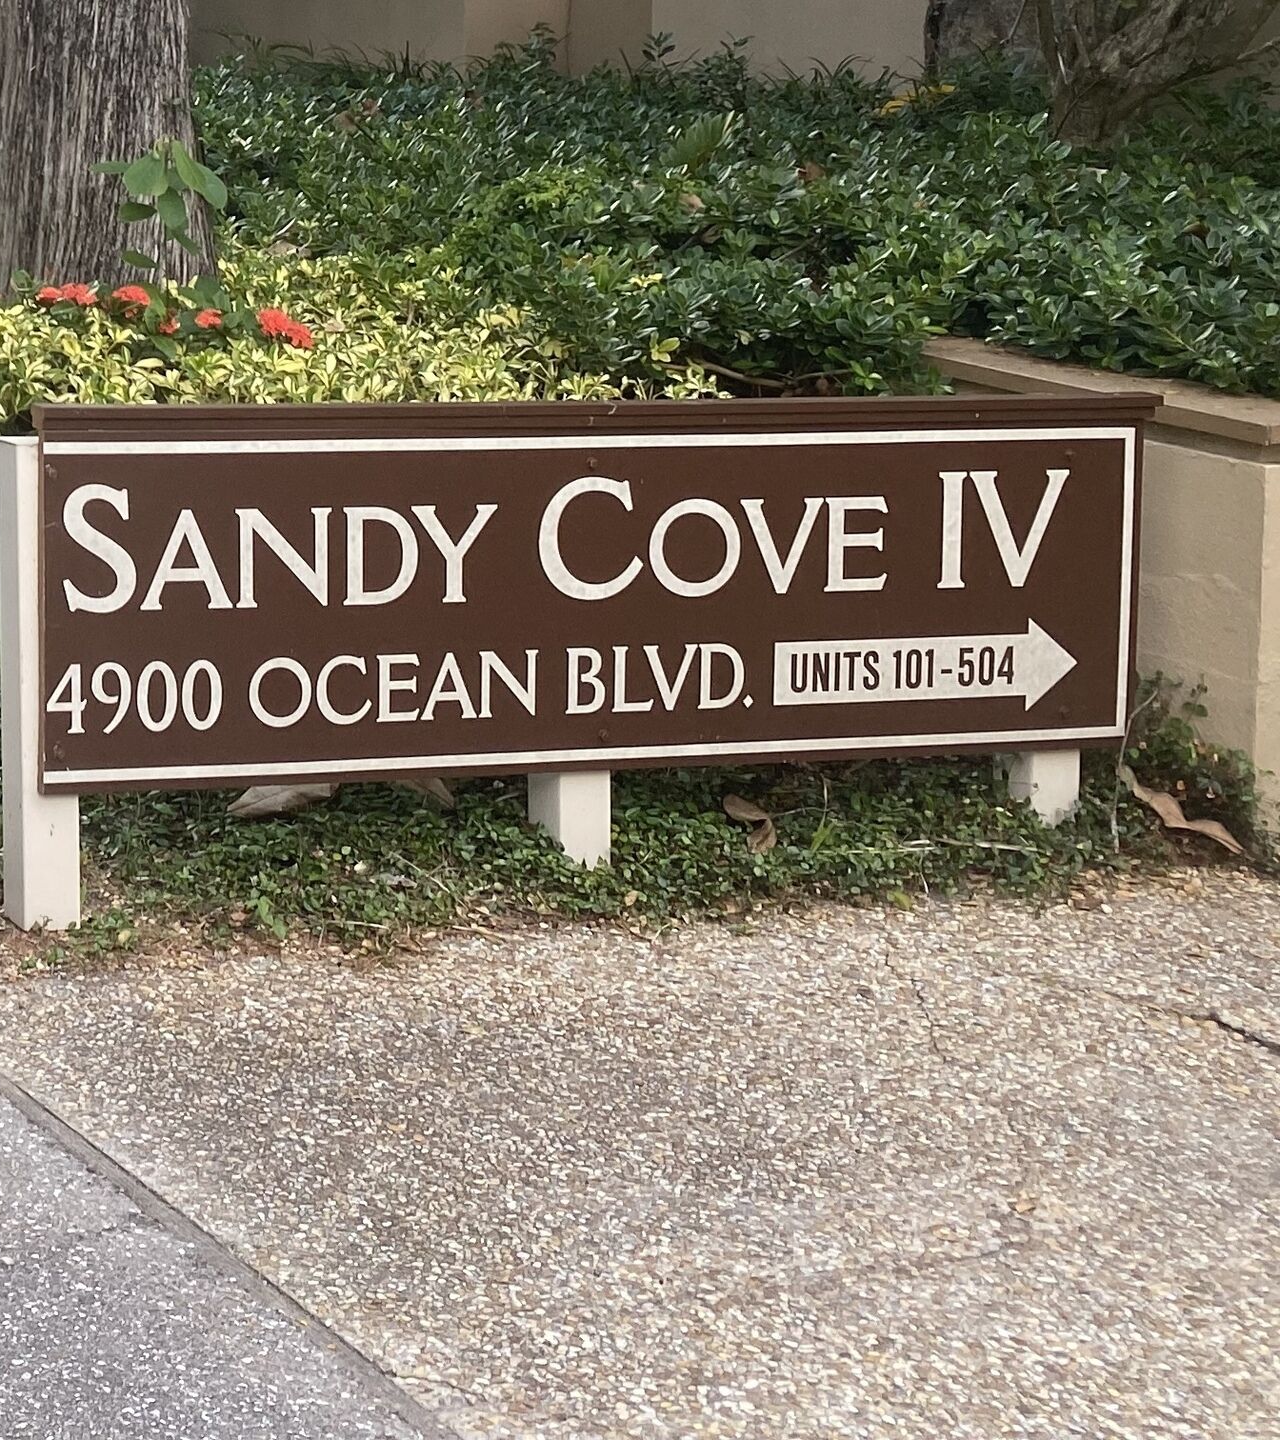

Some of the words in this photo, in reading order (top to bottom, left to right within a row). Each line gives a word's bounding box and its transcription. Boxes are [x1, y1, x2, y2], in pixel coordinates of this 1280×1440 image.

[62, 483, 498, 614] SANDY
[539, 476, 888, 600] COVE
[937, 469, 1070, 589] IV
[46, 660, 223, 735] 4900
[248, 649, 539, 728] OCEAN
[565, 642, 754, 715] BLVD.
[789, 651, 880, 693] UNITS
[893, 645, 1015, 689] 101-504
